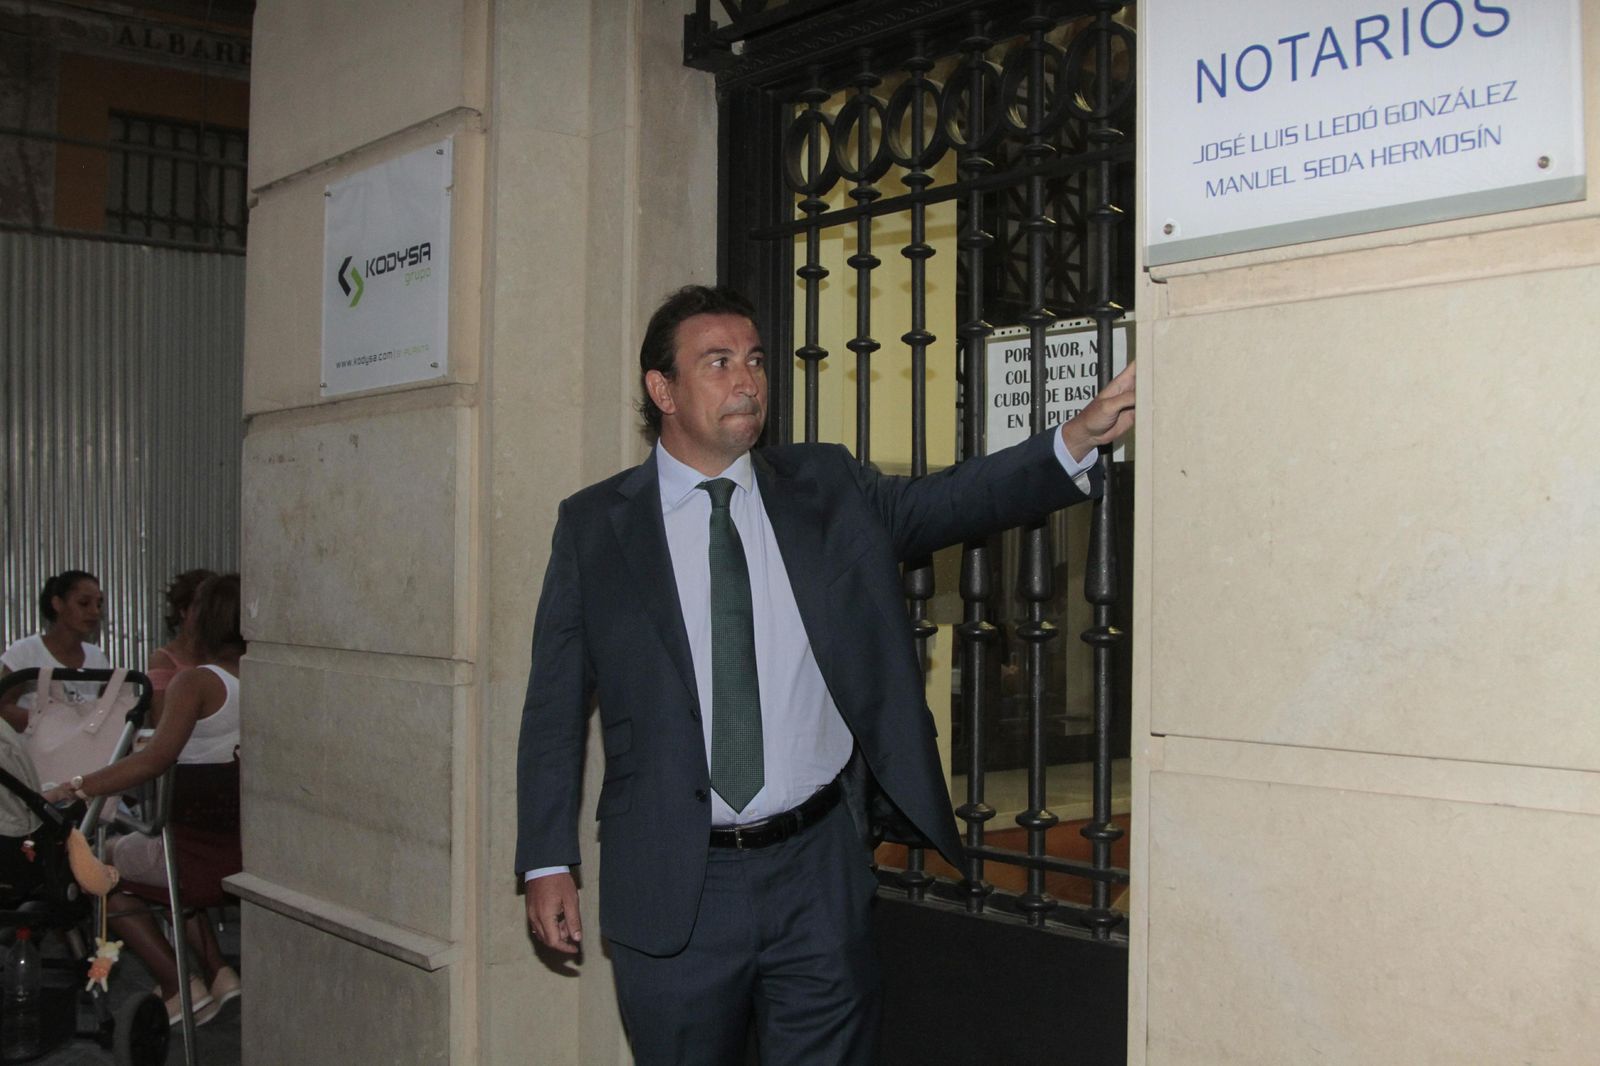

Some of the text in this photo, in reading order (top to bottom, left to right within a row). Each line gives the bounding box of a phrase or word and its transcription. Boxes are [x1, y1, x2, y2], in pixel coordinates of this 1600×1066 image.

[1197, 0, 1511, 103] NOTARIOS
[1192, 79, 1518, 165] JOSÉ LUIS LLEDÓ GONZÁLEZ
[1206, 123, 1502, 199] MANUEL SEDA HERMOSÍN
[365, 242, 431, 278] KODYSA
[404, 267, 431, 287] grupo
[335, 351, 393, 369] www.kodysa.com
[1004, 347, 1031, 364] POR
[1045, 341, 1084, 358] AVOR,
[1005, 362, 1098, 385] COLUEN LO
[994, 390, 1030, 408] CUBO
[1007, 414, 1024, 429] EN
